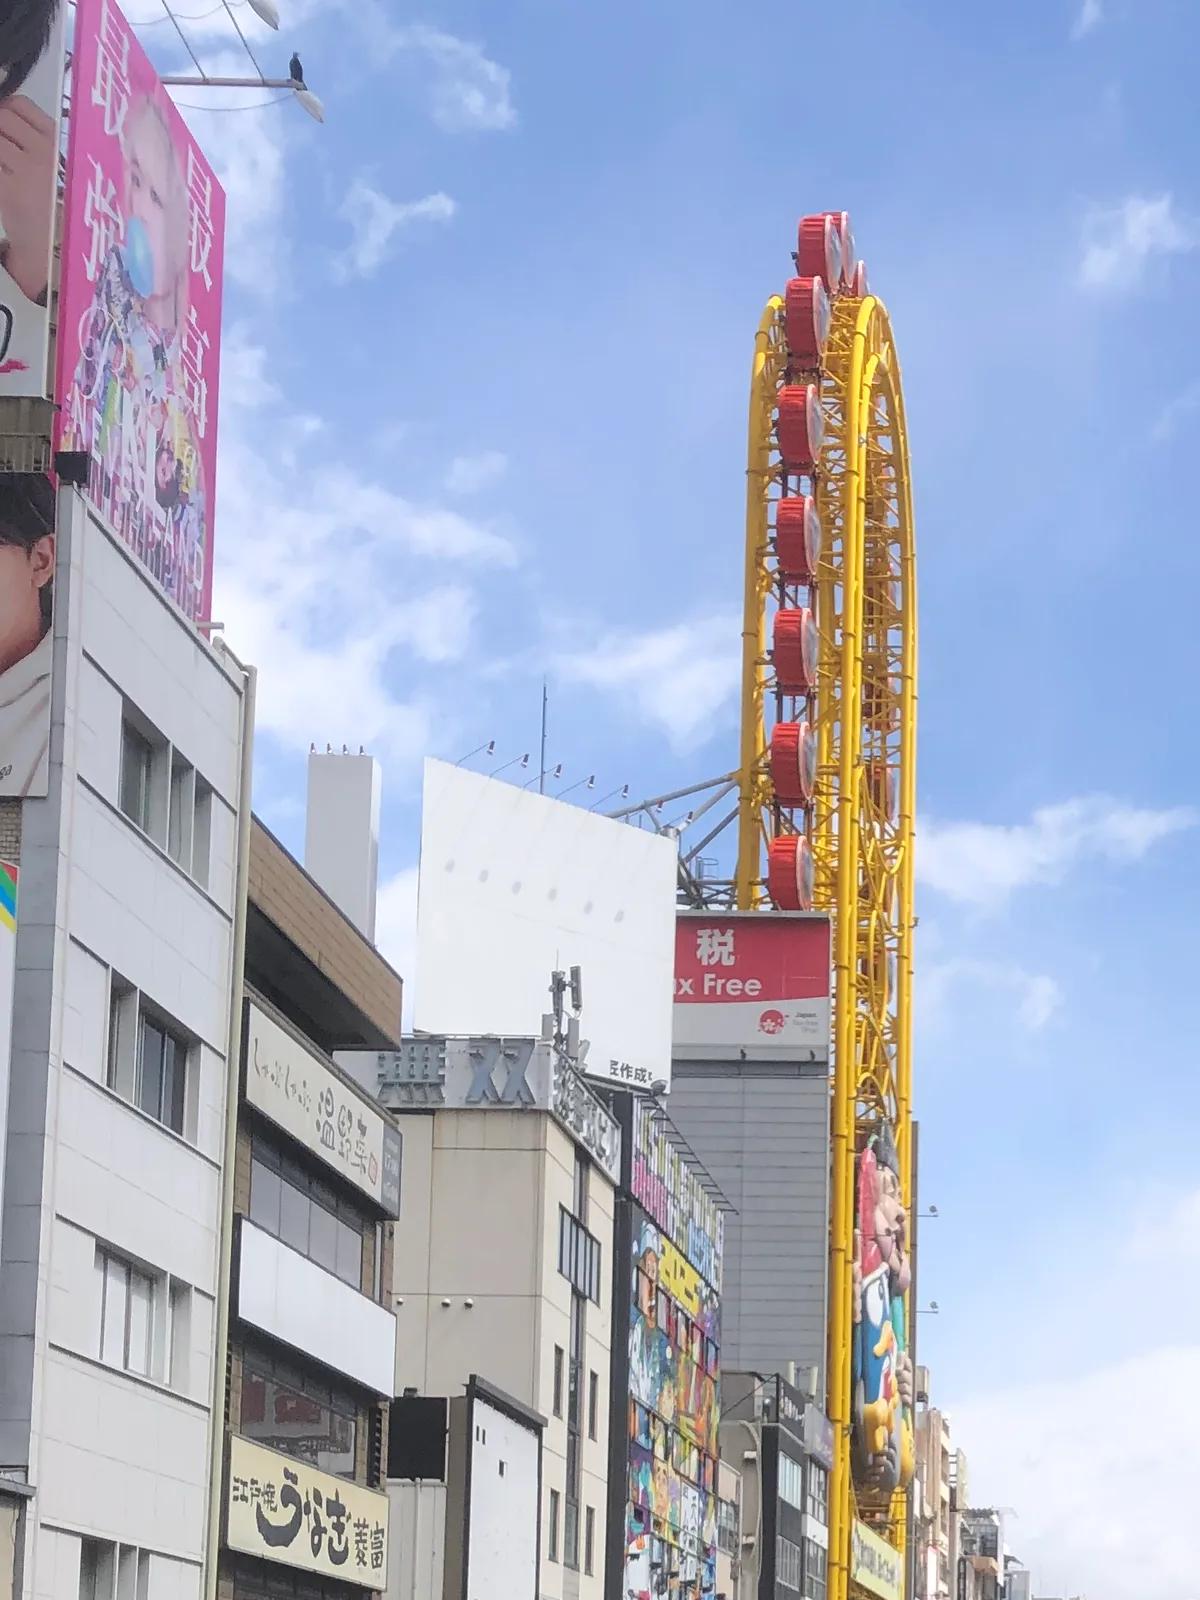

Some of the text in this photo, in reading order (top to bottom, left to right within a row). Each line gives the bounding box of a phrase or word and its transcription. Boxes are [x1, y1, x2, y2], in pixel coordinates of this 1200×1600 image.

[695, 928, 736, 966] 税
[673, 973, 763, 996] x Free
[253, 1037, 312, 1114] しゃぶしゃぶ
[315, 1087, 369, 1176] 温野菜
[232, 1466, 385, 1570] 江戸焼 うなぎ 菱富
